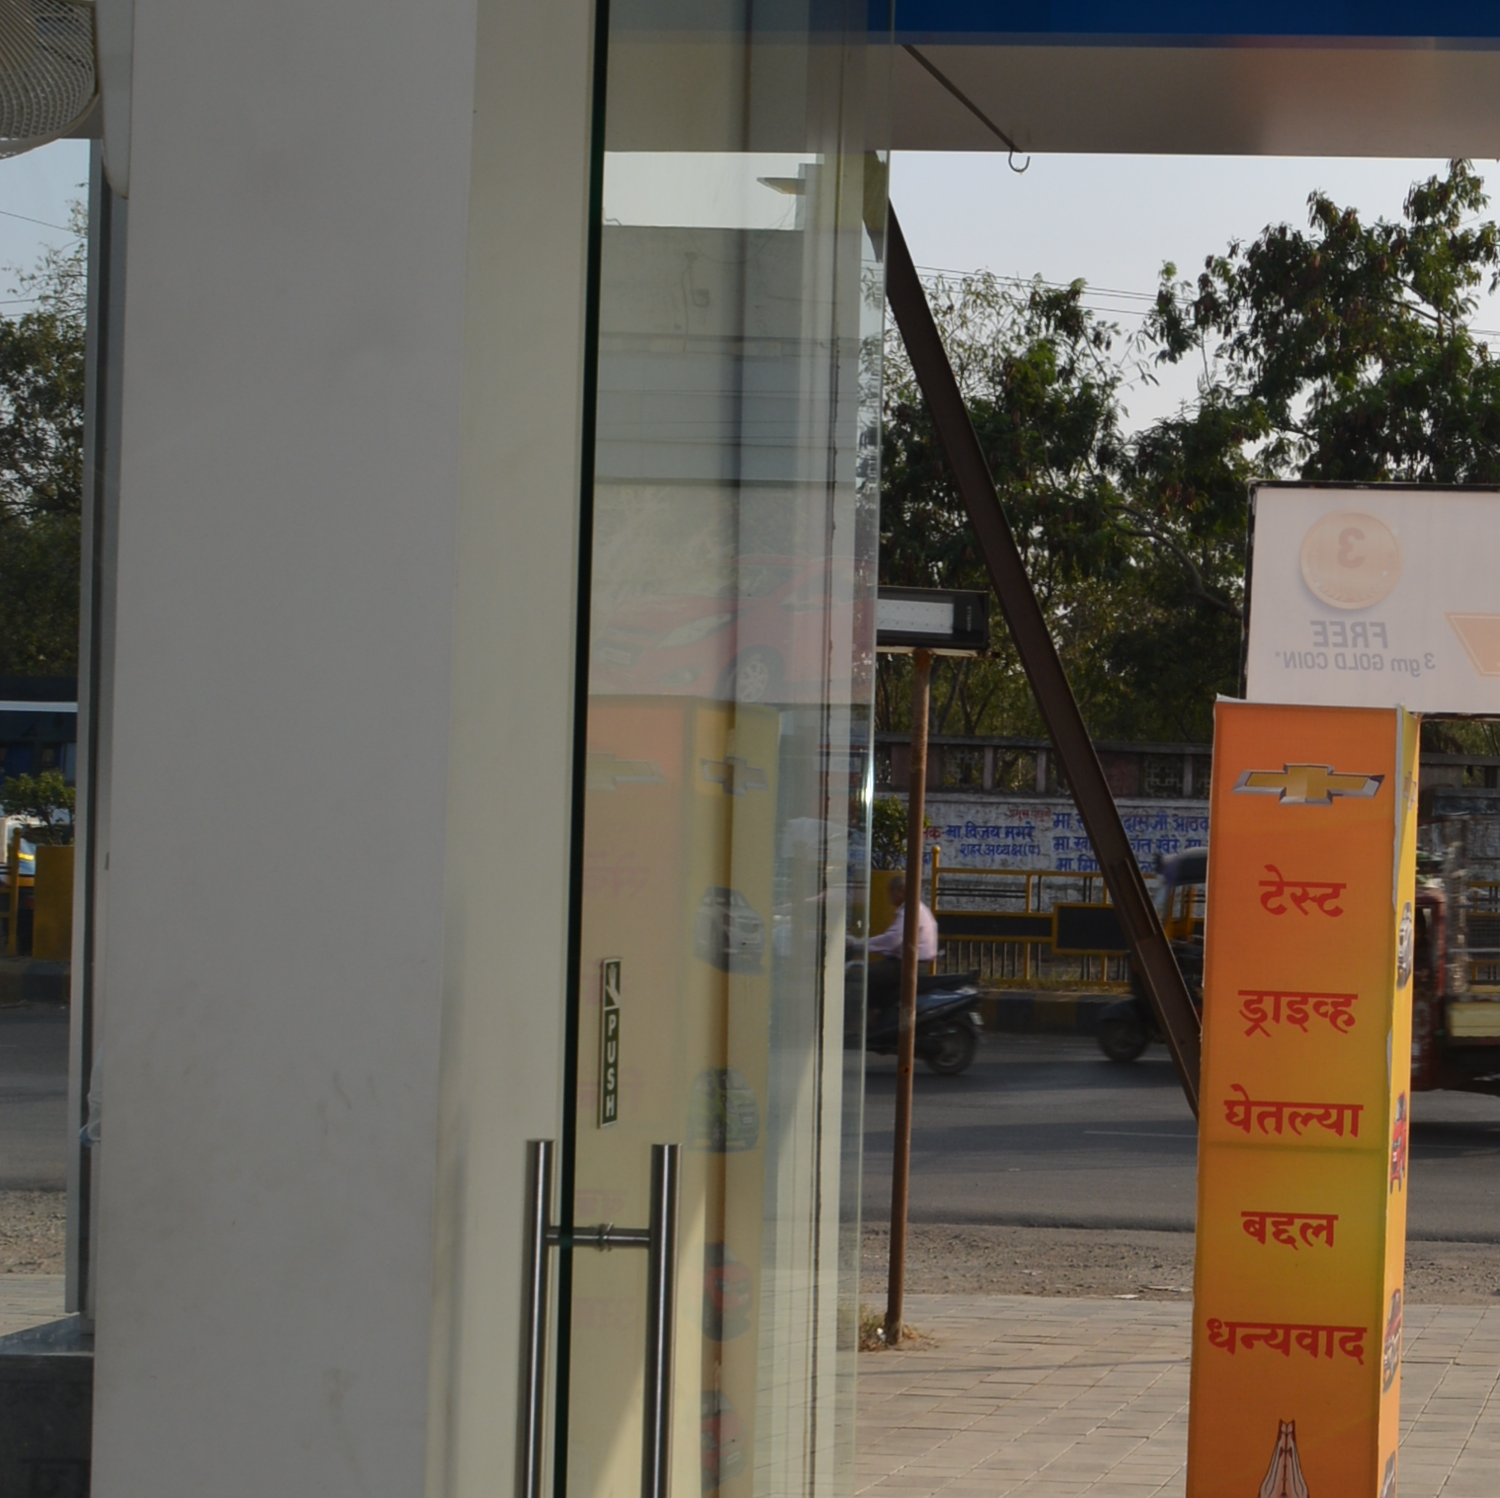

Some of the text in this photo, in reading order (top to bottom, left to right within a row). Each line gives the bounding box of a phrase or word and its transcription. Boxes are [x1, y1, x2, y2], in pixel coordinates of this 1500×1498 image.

[1259, 864, 1346, 917] टेस्ट
[605, 1013, 618, 1117] PUSH
[1222, 1083, 1364, 1138] घेतल्या
[1240, 1210, 1339, 1251] बद्दल
[1206, 1317, 1368, 1365] धन्यवाद
